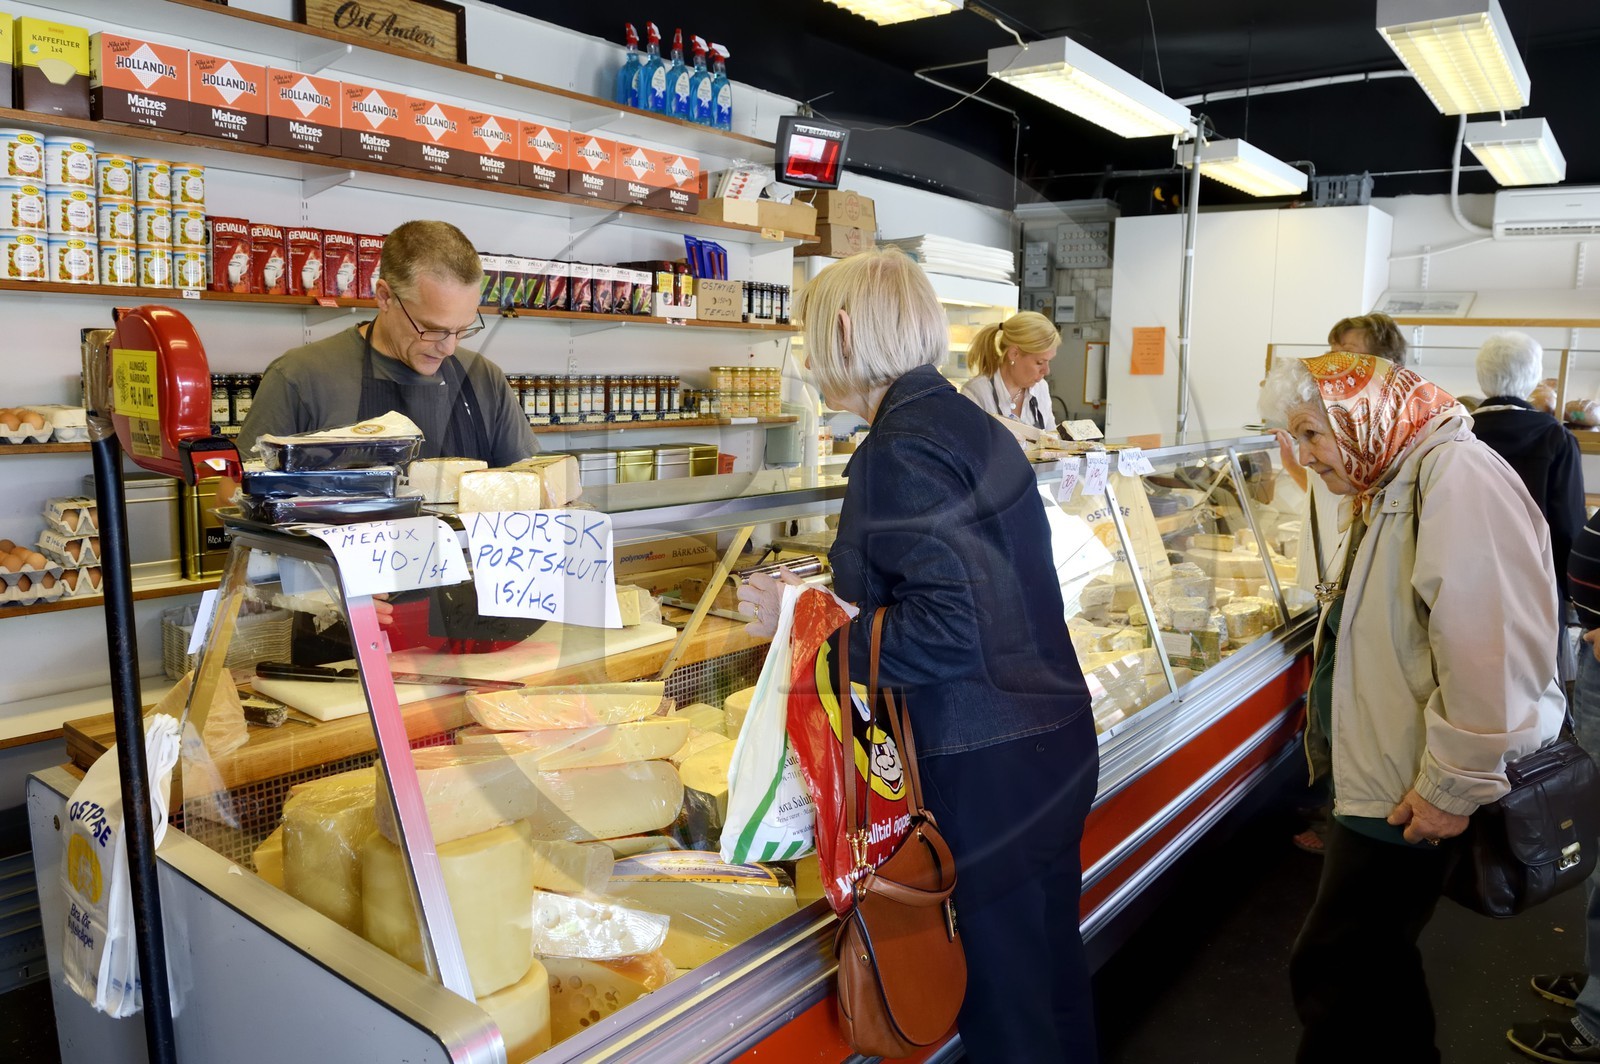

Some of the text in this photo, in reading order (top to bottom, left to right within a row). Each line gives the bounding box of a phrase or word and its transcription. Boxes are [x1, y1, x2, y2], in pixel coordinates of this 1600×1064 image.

[333, 1, 437, 48] Ost Anders
[32, 34, 80, 49] KAFFEFILTER
[51, 46, 63, 54] 1x4
[116, 56, 176, 78] HOLLANDIA
[202, 73, 256, 94] HOLLANDIA
[128, 93, 167, 111] Matzes
[280, 88, 331, 107] HOLLANDIA
[131, 106, 164, 118] NATUREL
[212, 108, 247, 126] Matzes
[352, 101, 398, 119] HOLLANDIA
[215, 121, 245, 132] NATUREL
[289, 121, 322, 138] Matzes
[415, 114, 457, 132] HOLLANDIA
[293, 133, 320, 143] NATUREL
[360, 133, 390, 148] Matzes
[473, 127, 512, 143] HOLLANDIA
[363, 144, 388, 153] NATUREL
[422, 145, 450, 159] Matzes
[528, 137, 562, 153] HOLLANDIA
[577, 147, 610, 162] HOLLANDIA
[480, 156, 505, 169] Matzes
[533, 165, 556, 178] Matzes
[582, 173, 604, 187] Matzes
[216, 222, 247, 236] GEVALIA
[251, 227, 282, 239] GEVALIA
[289, 230, 320, 242] GEVALIA
[326, 234, 354, 246] GEVALIA
[360, 238, 384, 248] GEVALI
[472, 511, 604, 549] NORSK
[342, 528, 418, 548] MEAUX
[476, 545, 612, 583] PORTSALUT!
